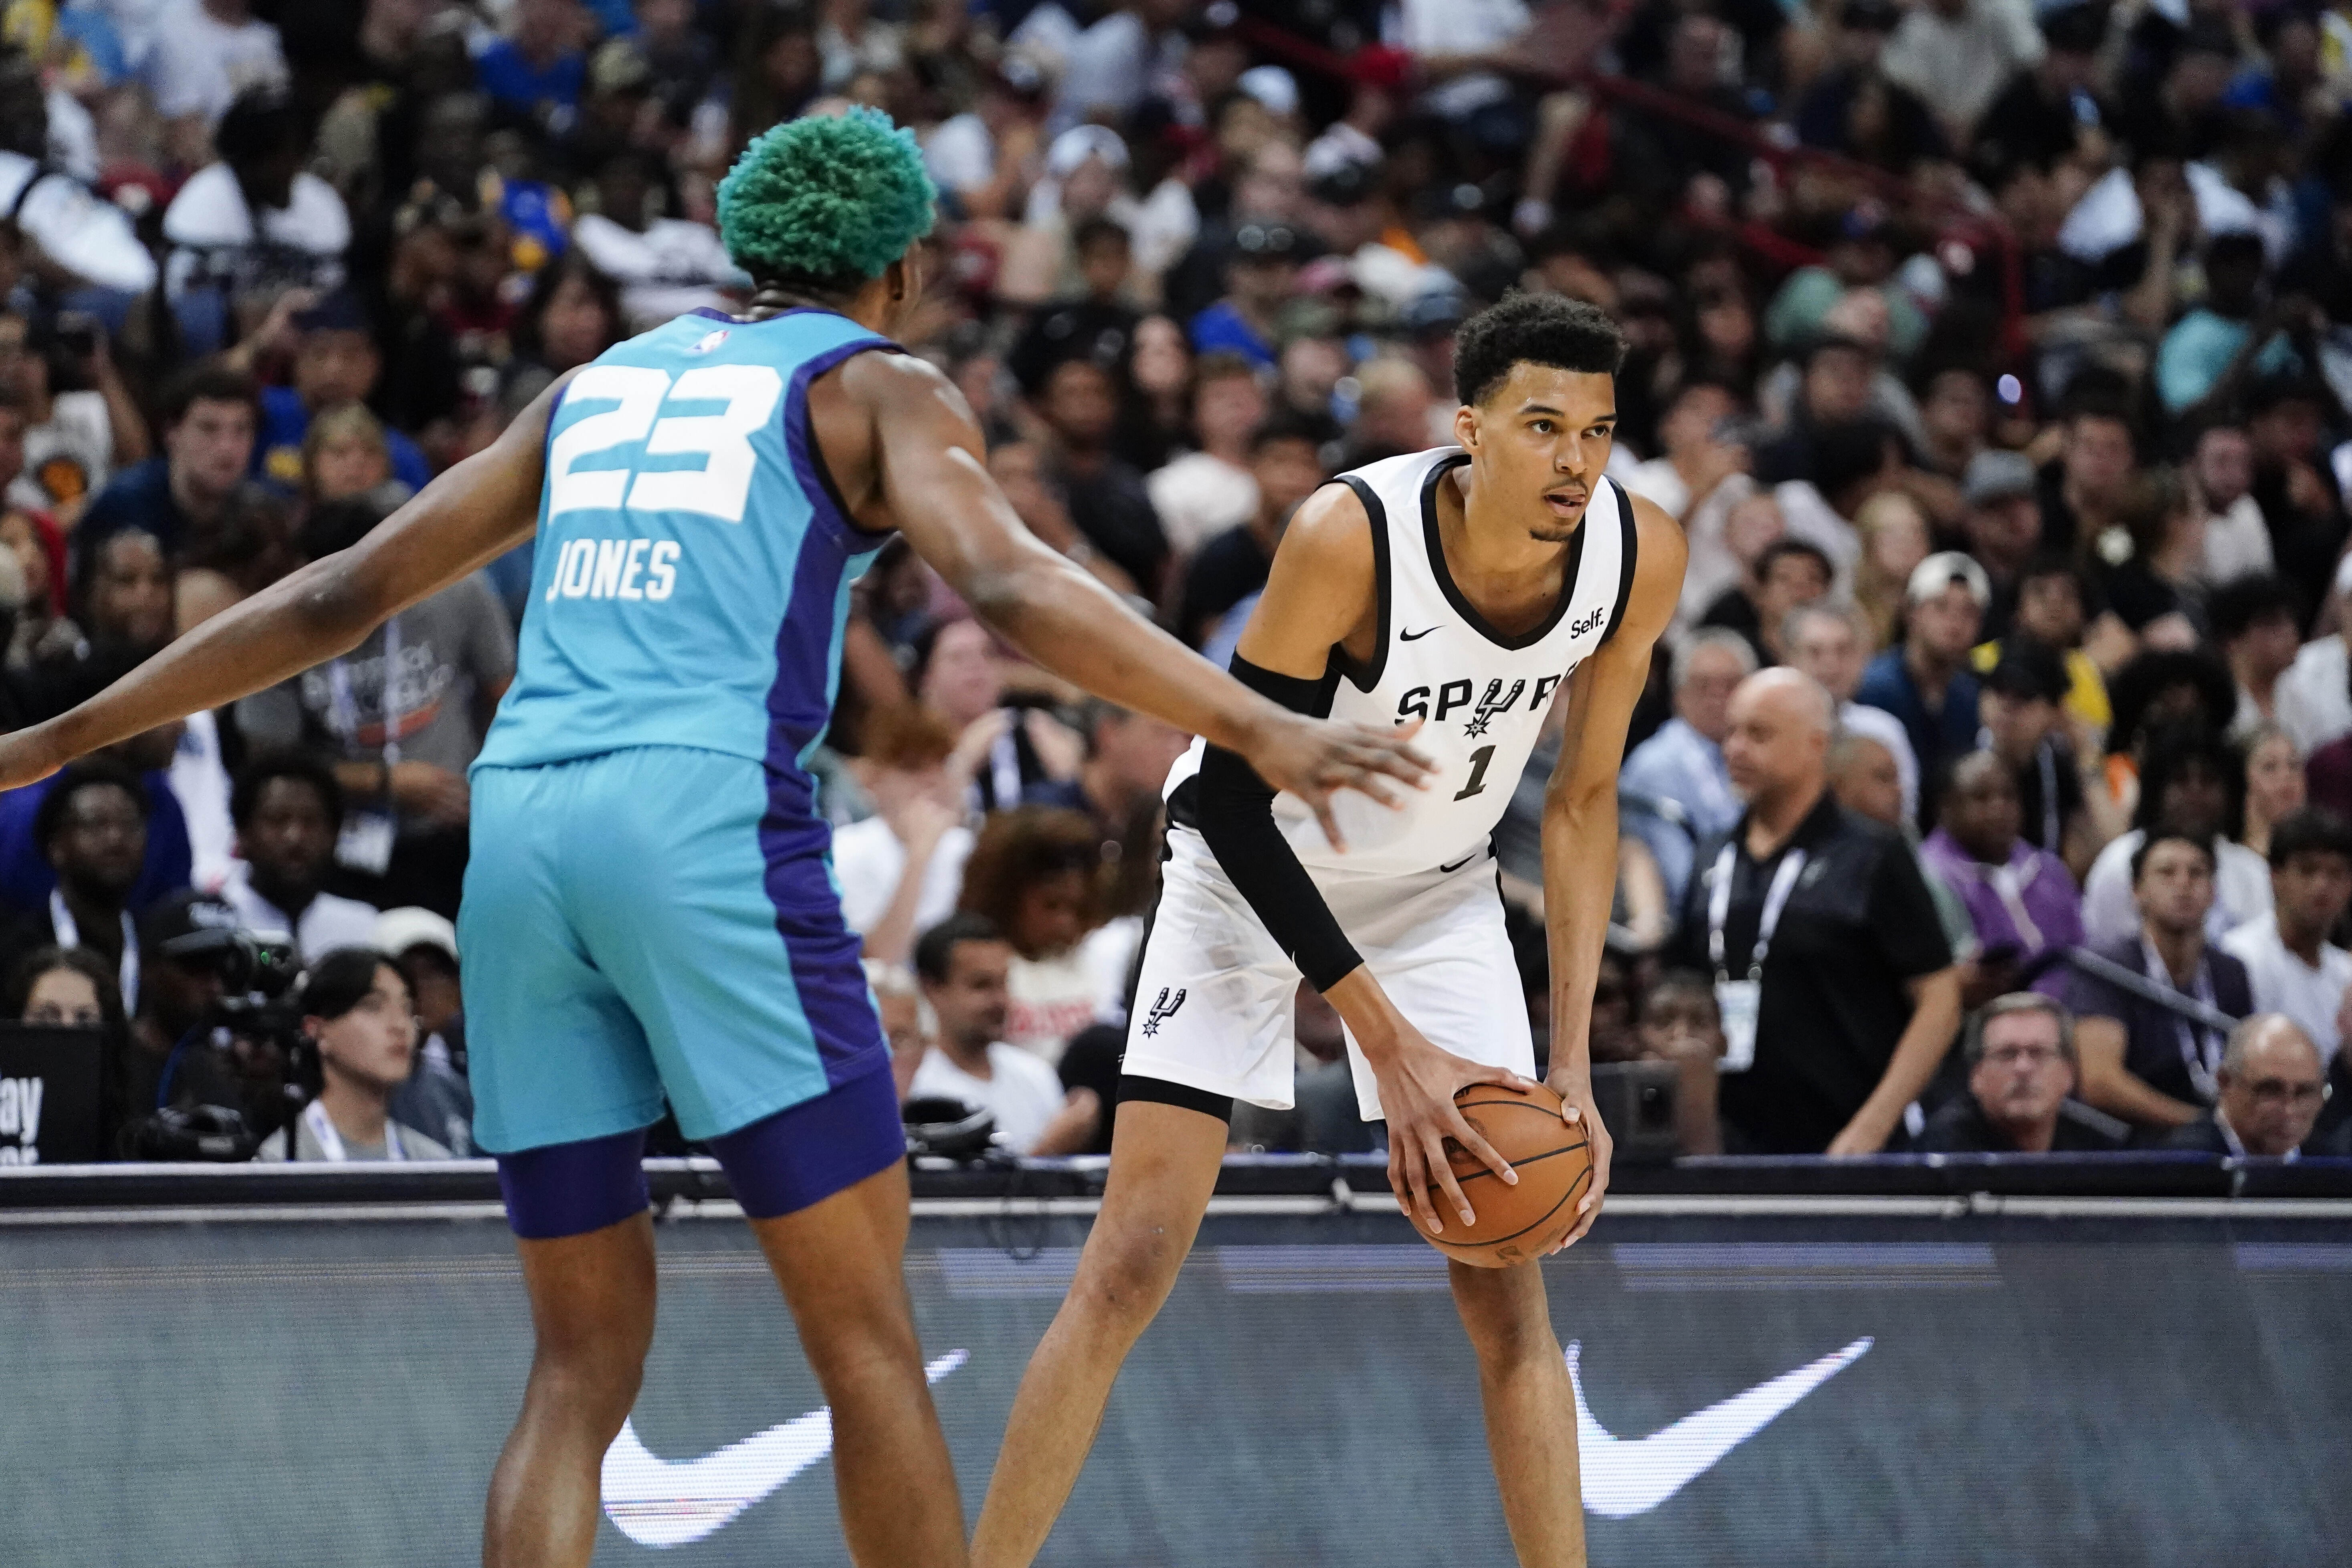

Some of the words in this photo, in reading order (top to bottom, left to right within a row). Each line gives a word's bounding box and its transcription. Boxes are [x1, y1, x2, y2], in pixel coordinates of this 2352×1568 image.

[548, 364, 783, 526] 23
[546, 539, 681, 604] JONES
[1571, 607, 1604, 639] Self.
[1453, 745, 1496, 802] 1
